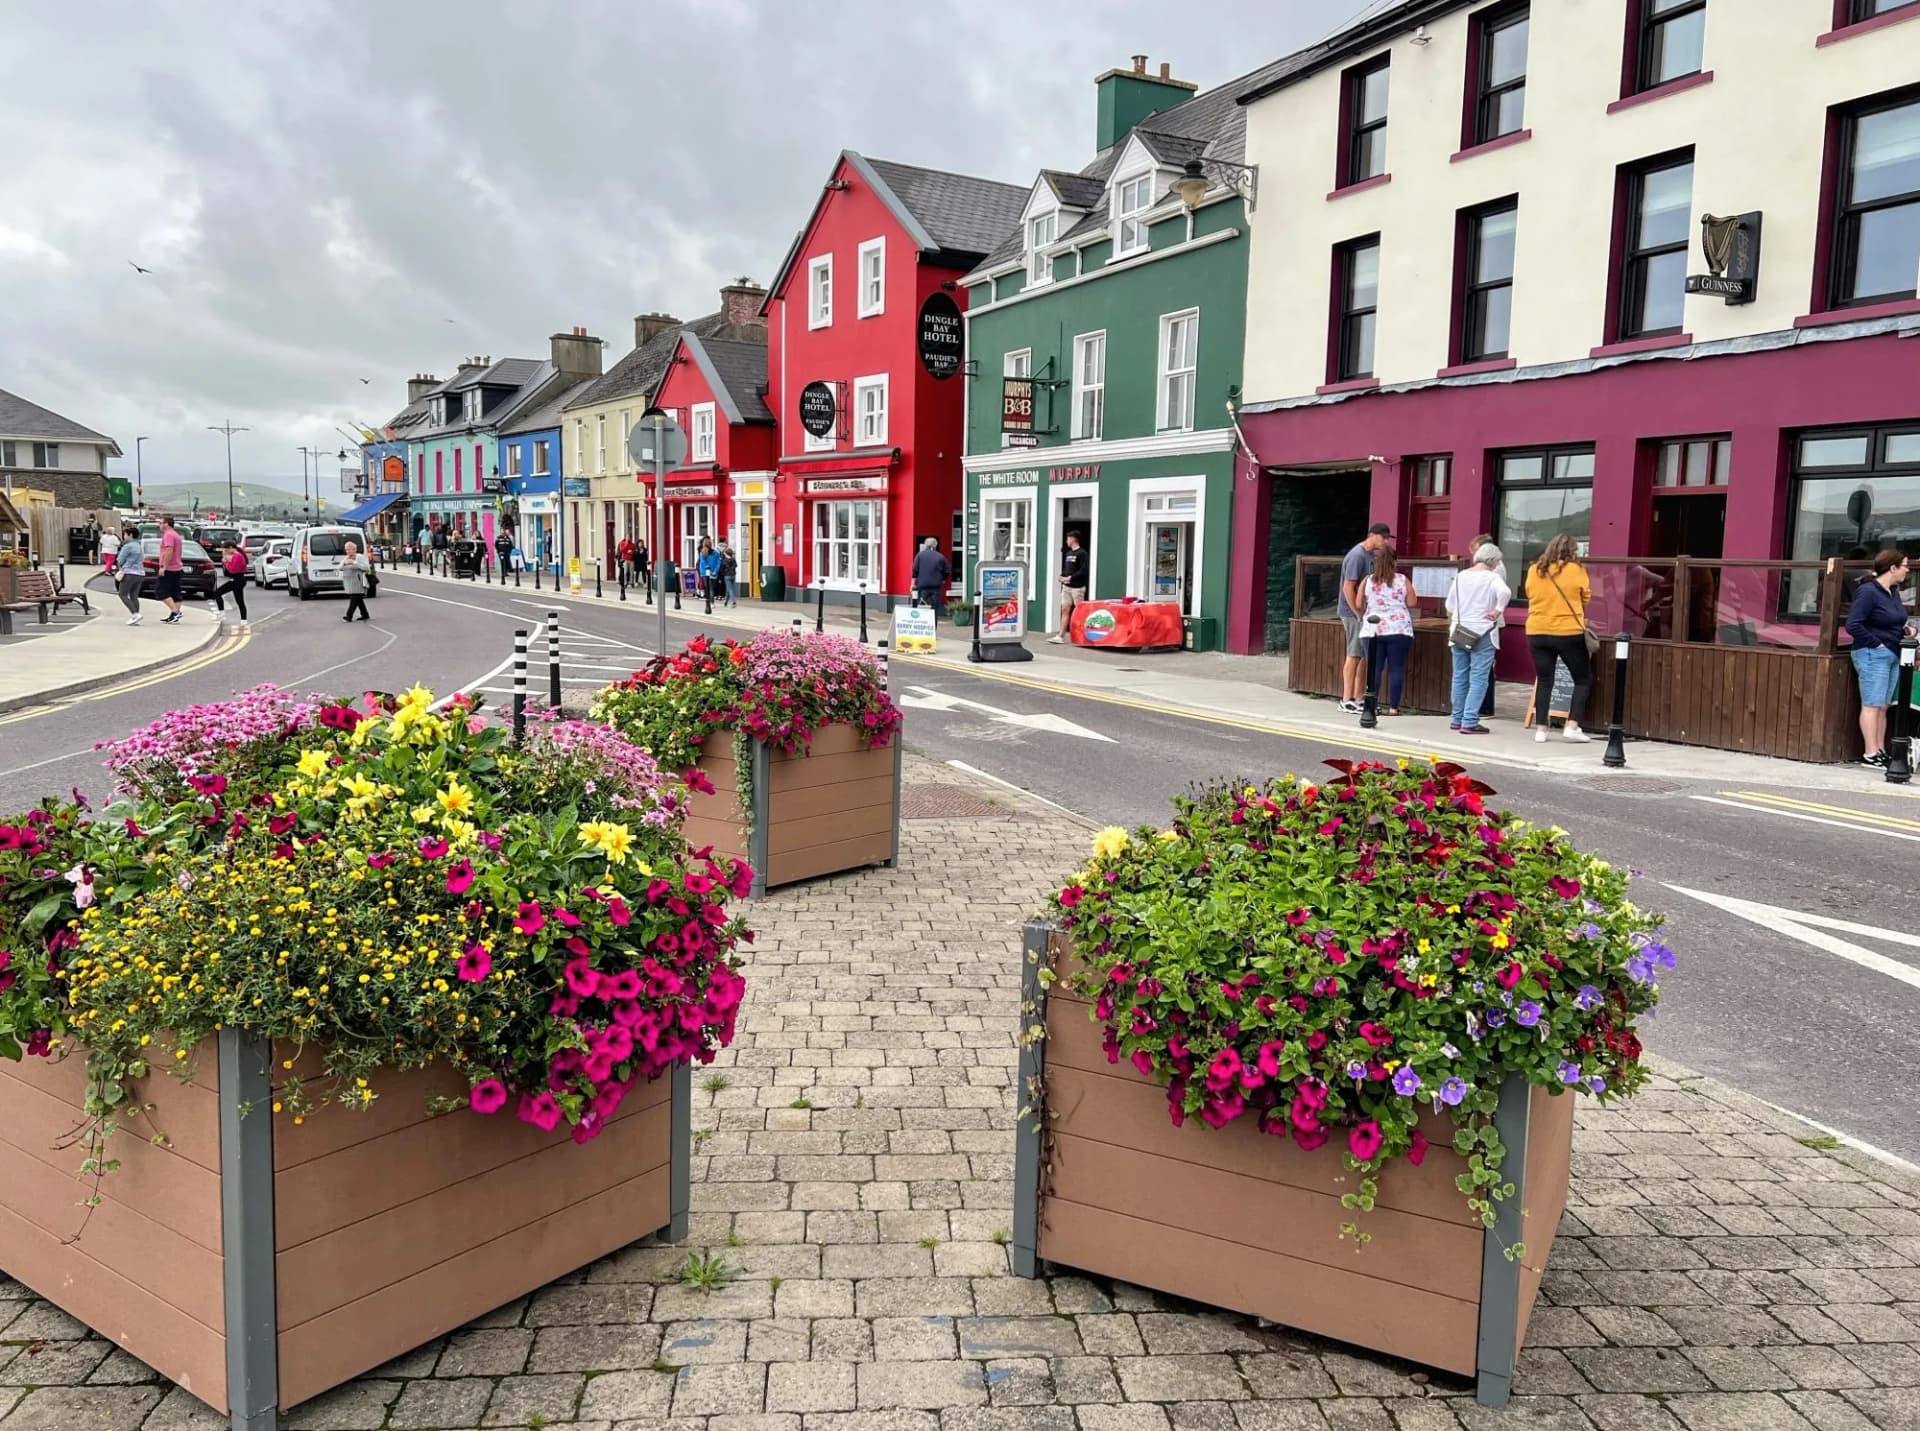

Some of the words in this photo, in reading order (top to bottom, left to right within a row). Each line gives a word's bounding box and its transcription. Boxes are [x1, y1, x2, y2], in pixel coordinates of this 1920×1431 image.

[1701, 277, 1743, 293] GUINNESS
[924, 314, 959, 326] DINGLE
[933, 324, 950, 333] BAY
[923, 331, 959, 344] HOTEL
[925, 353, 958, 363] PAUDIE'S
[934, 361, 949, 369] BAR
[805, 391, 830, 399] DINGLE
[804, 403, 831, 412] HOTEL
[1004, 398, 1031, 415] B&B
[1009, 436, 1037, 446] VACANCIES
[978, 473, 992, 485] THE
[992, 471, 1016, 484] WHITE
[1016, 470, 1040, 483] ROOM
[1048, 464, 1101, 481] MURPHY
